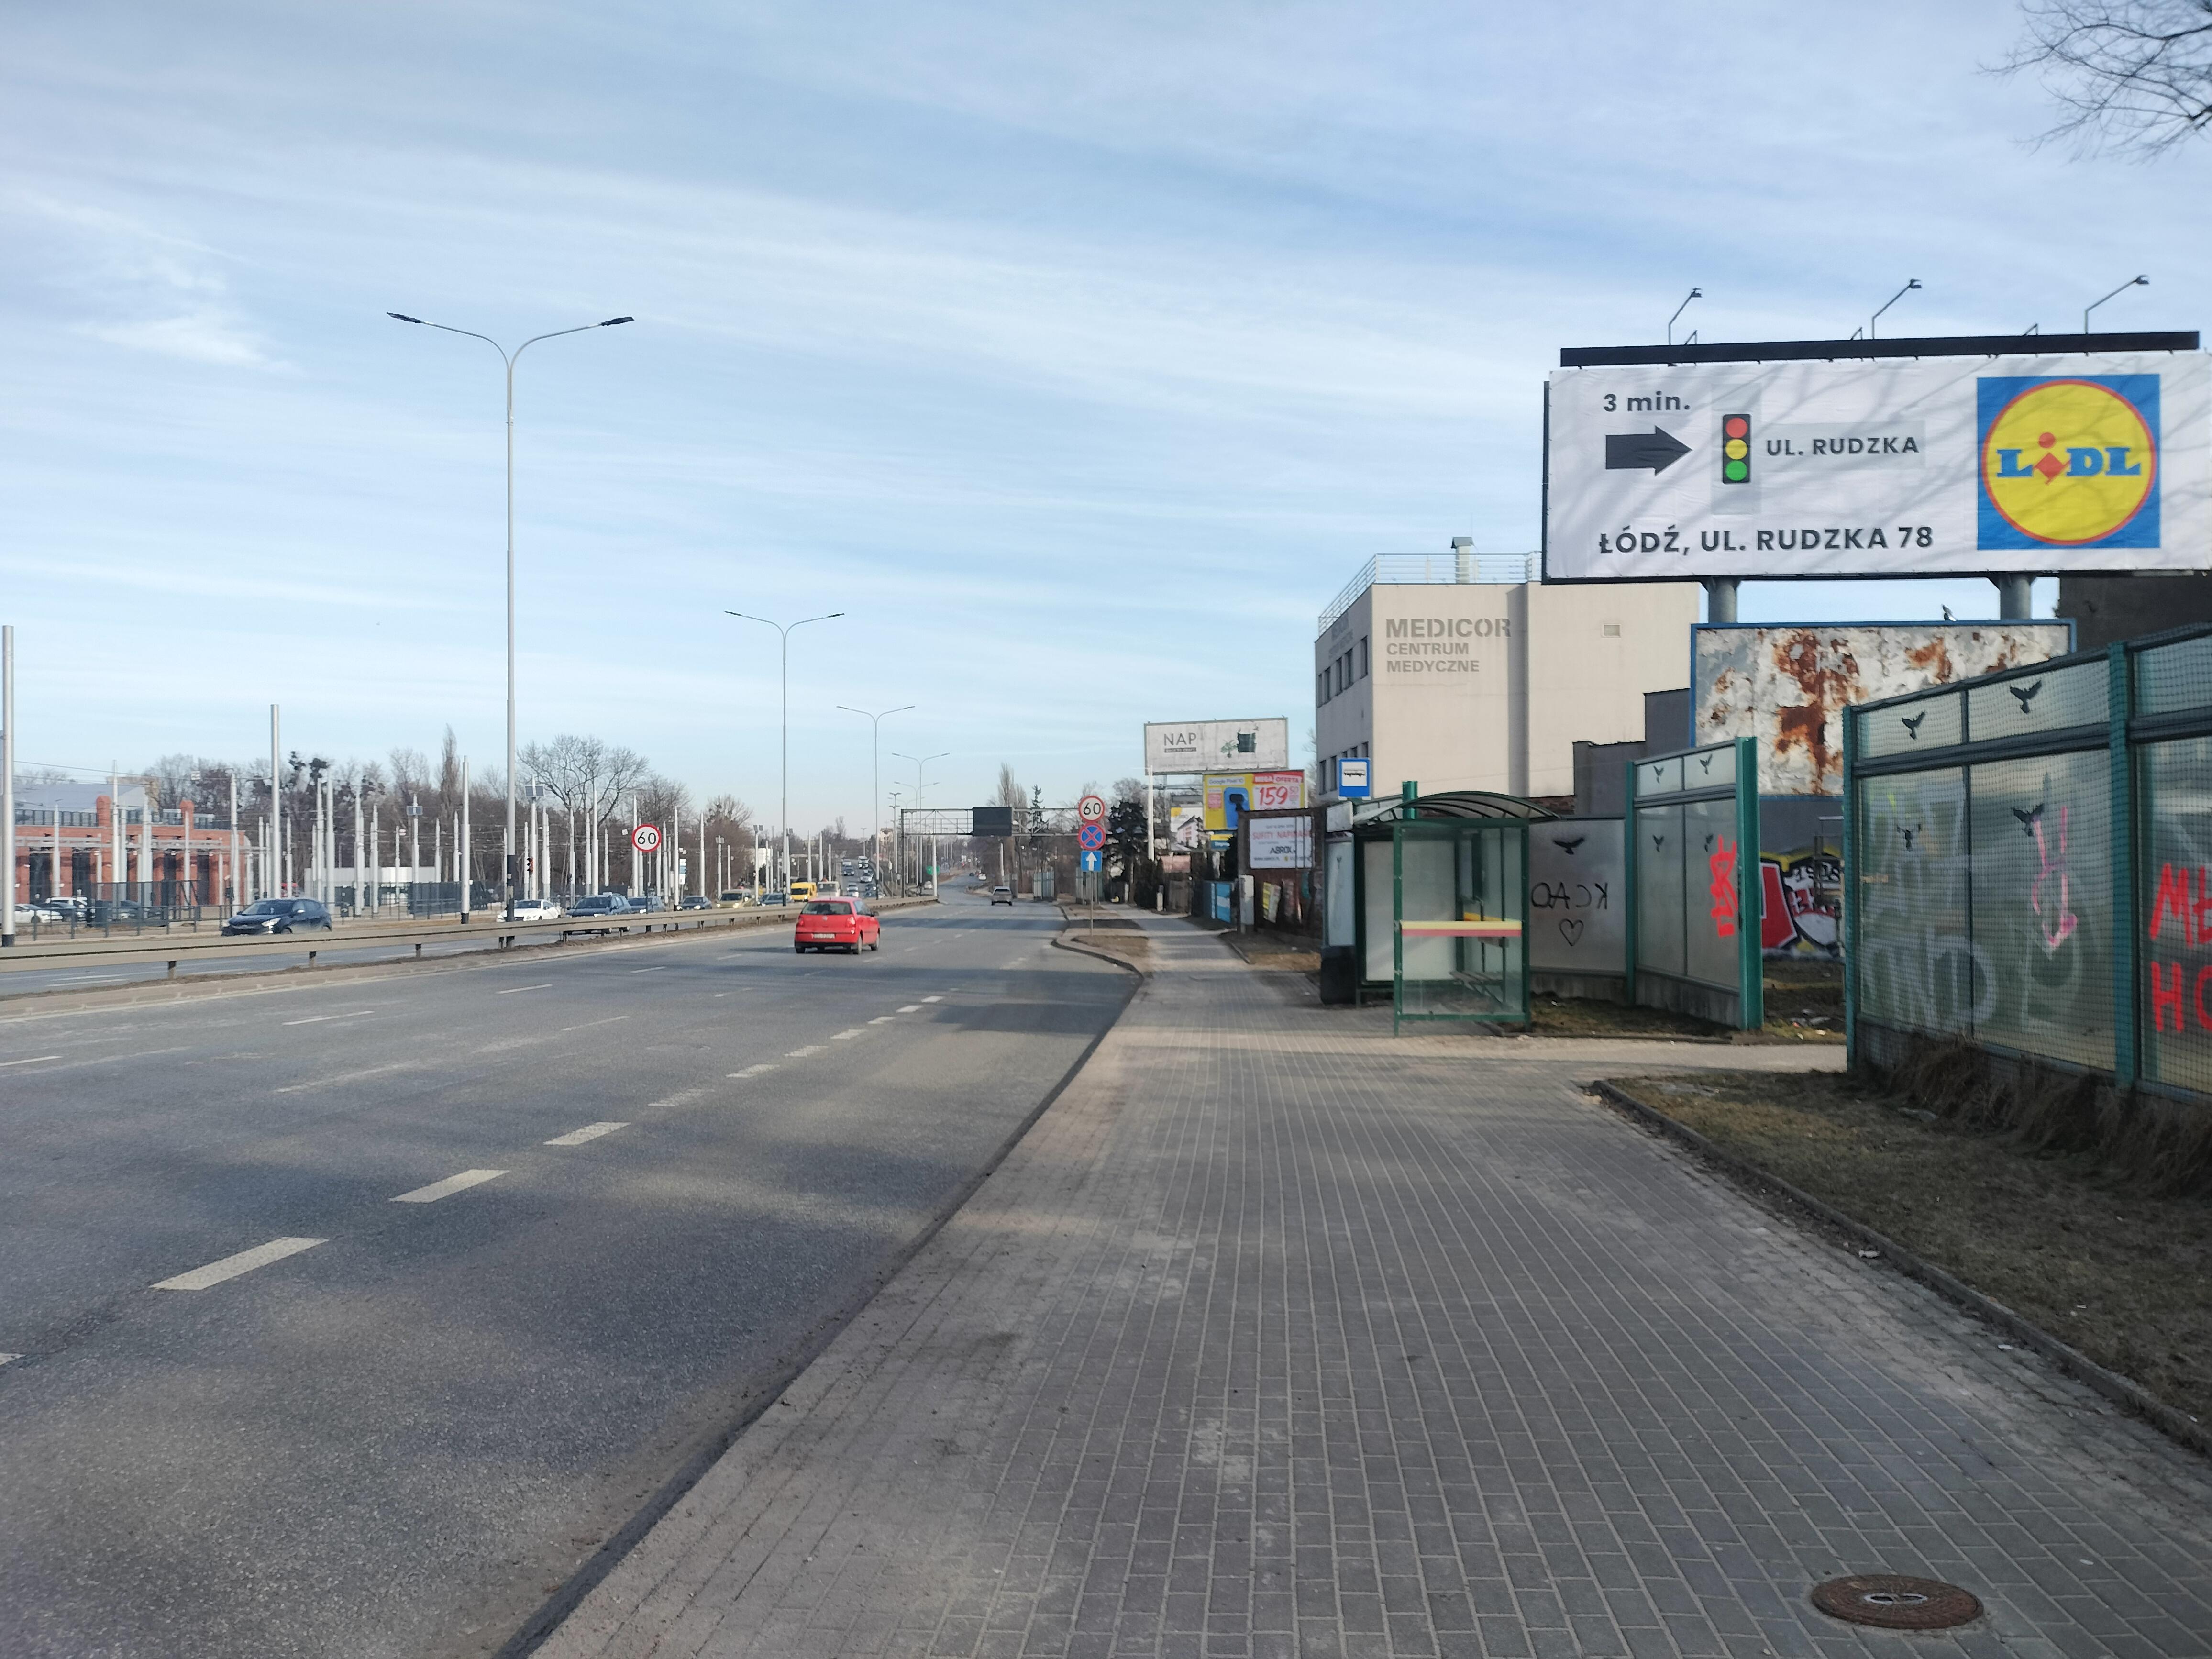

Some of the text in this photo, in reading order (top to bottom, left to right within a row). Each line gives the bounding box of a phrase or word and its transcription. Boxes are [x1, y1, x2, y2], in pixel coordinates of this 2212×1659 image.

[1604, 390, 1691, 412] 3 min.
[1767, 437, 1919, 456] UL. RUDZKA
[1599, 524, 1934, 556] ŁÓDŹ, UL. RUDZKA 78
[1386, 618, 1511, 638] MEDICOR
[1386, 643, 1469, 655] CENTRUM
[1387, 660, 1480, 673] MEDYCZNE
[1164, 732, 1197, 746] NAP
[1260, 786, 1288, 806] 159
[1083, 802, 1101, 815] 60
[637, 831, 656, 844] 60
